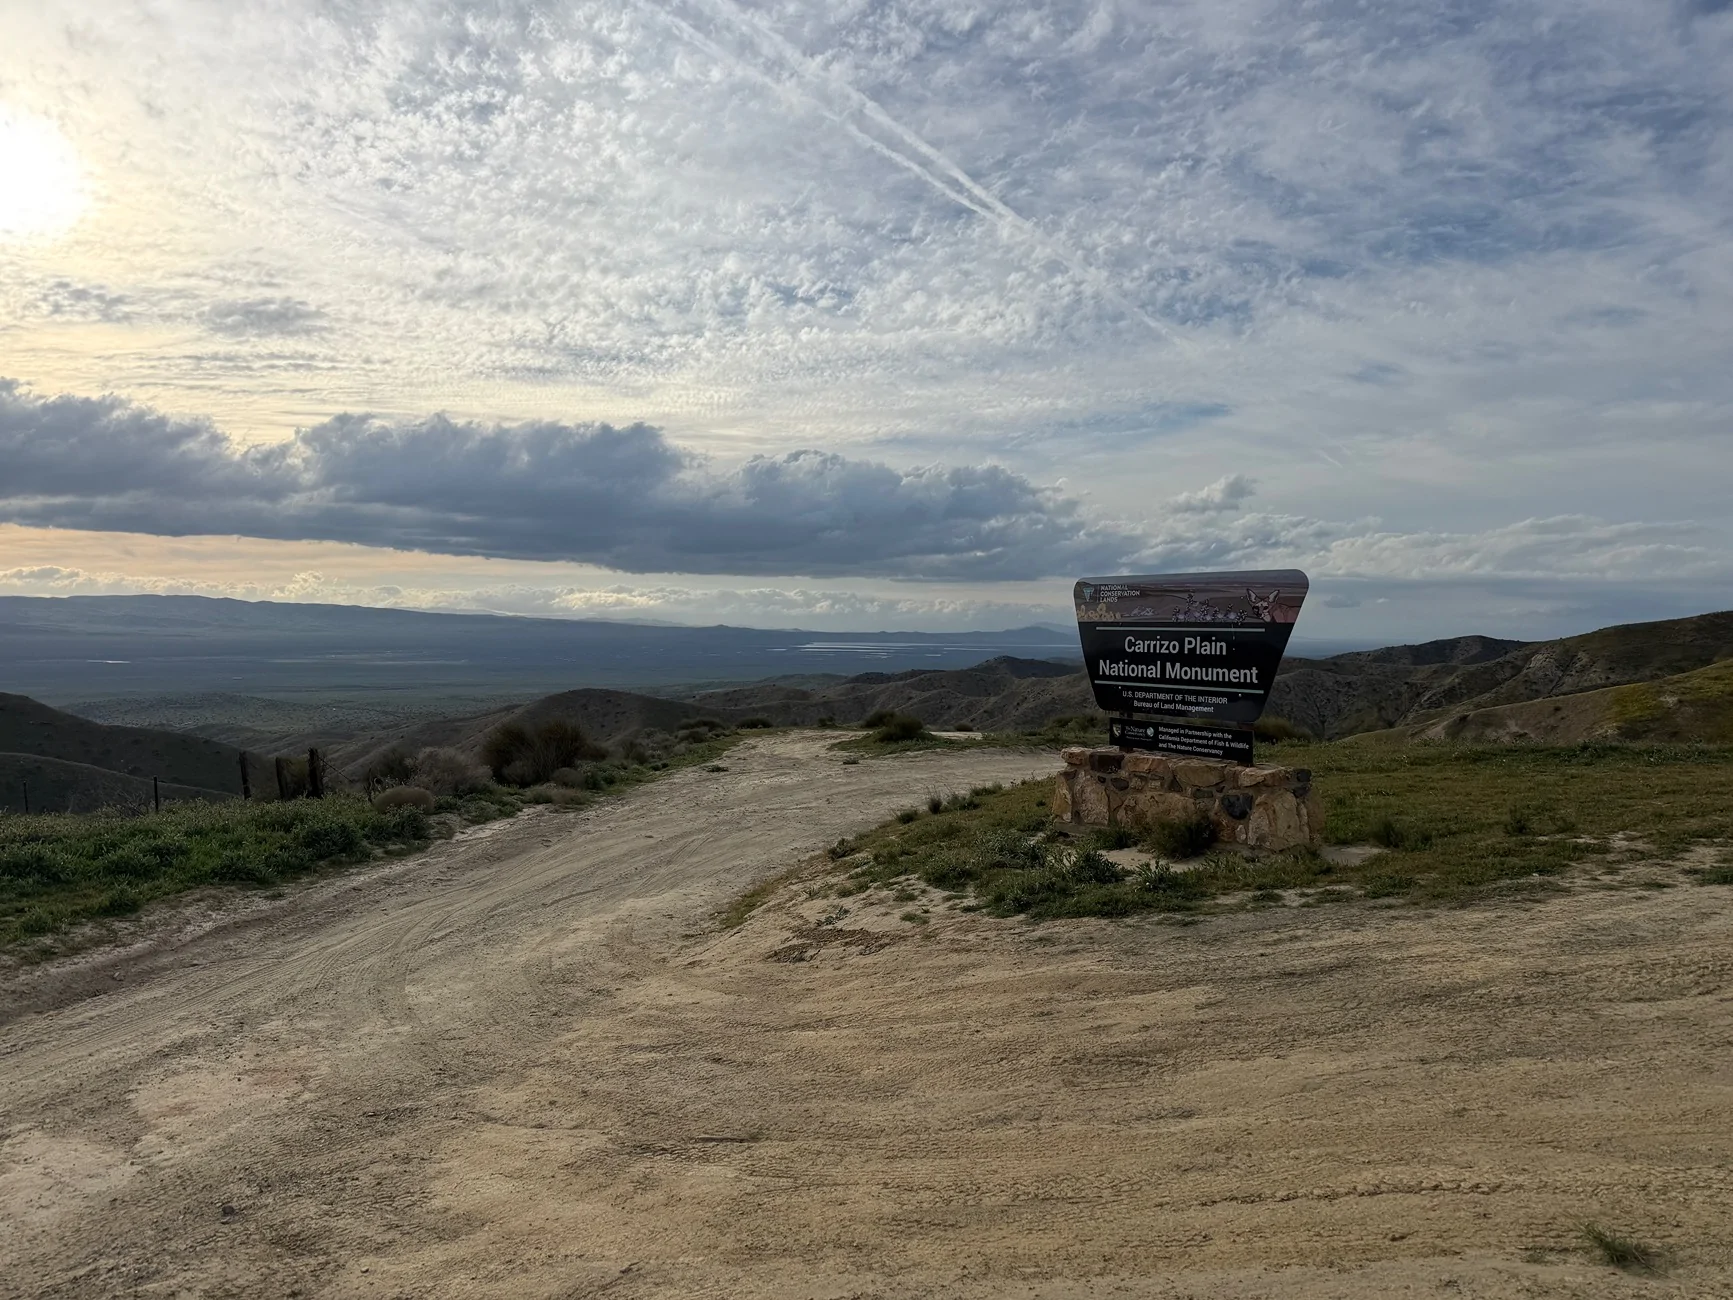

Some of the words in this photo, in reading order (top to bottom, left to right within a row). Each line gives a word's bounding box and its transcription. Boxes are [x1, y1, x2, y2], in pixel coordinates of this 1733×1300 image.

[1124, 636, 1179, 654] Carrizo
[1184, 637, 1227, 655] Plain
[1099, 660, 1161, 678] National
[1165, 662, 1259, 683] Monument
[1134, 692, 1174, 701] DEPARTMENT
[1184, 695, 1197, 703] THE
[1198, 696, 1228, 705] INTERIOR
[1133, 700, 1153, 708] Bureau
[1160, 702, 1175, 710] Land
[1175, 704, 1214, 713] Management
[1181, 736, 1207, 744] Department
[1185, 729, 1212, 738] Partnership
[1193, 746, 1223, 755] Conservancy
